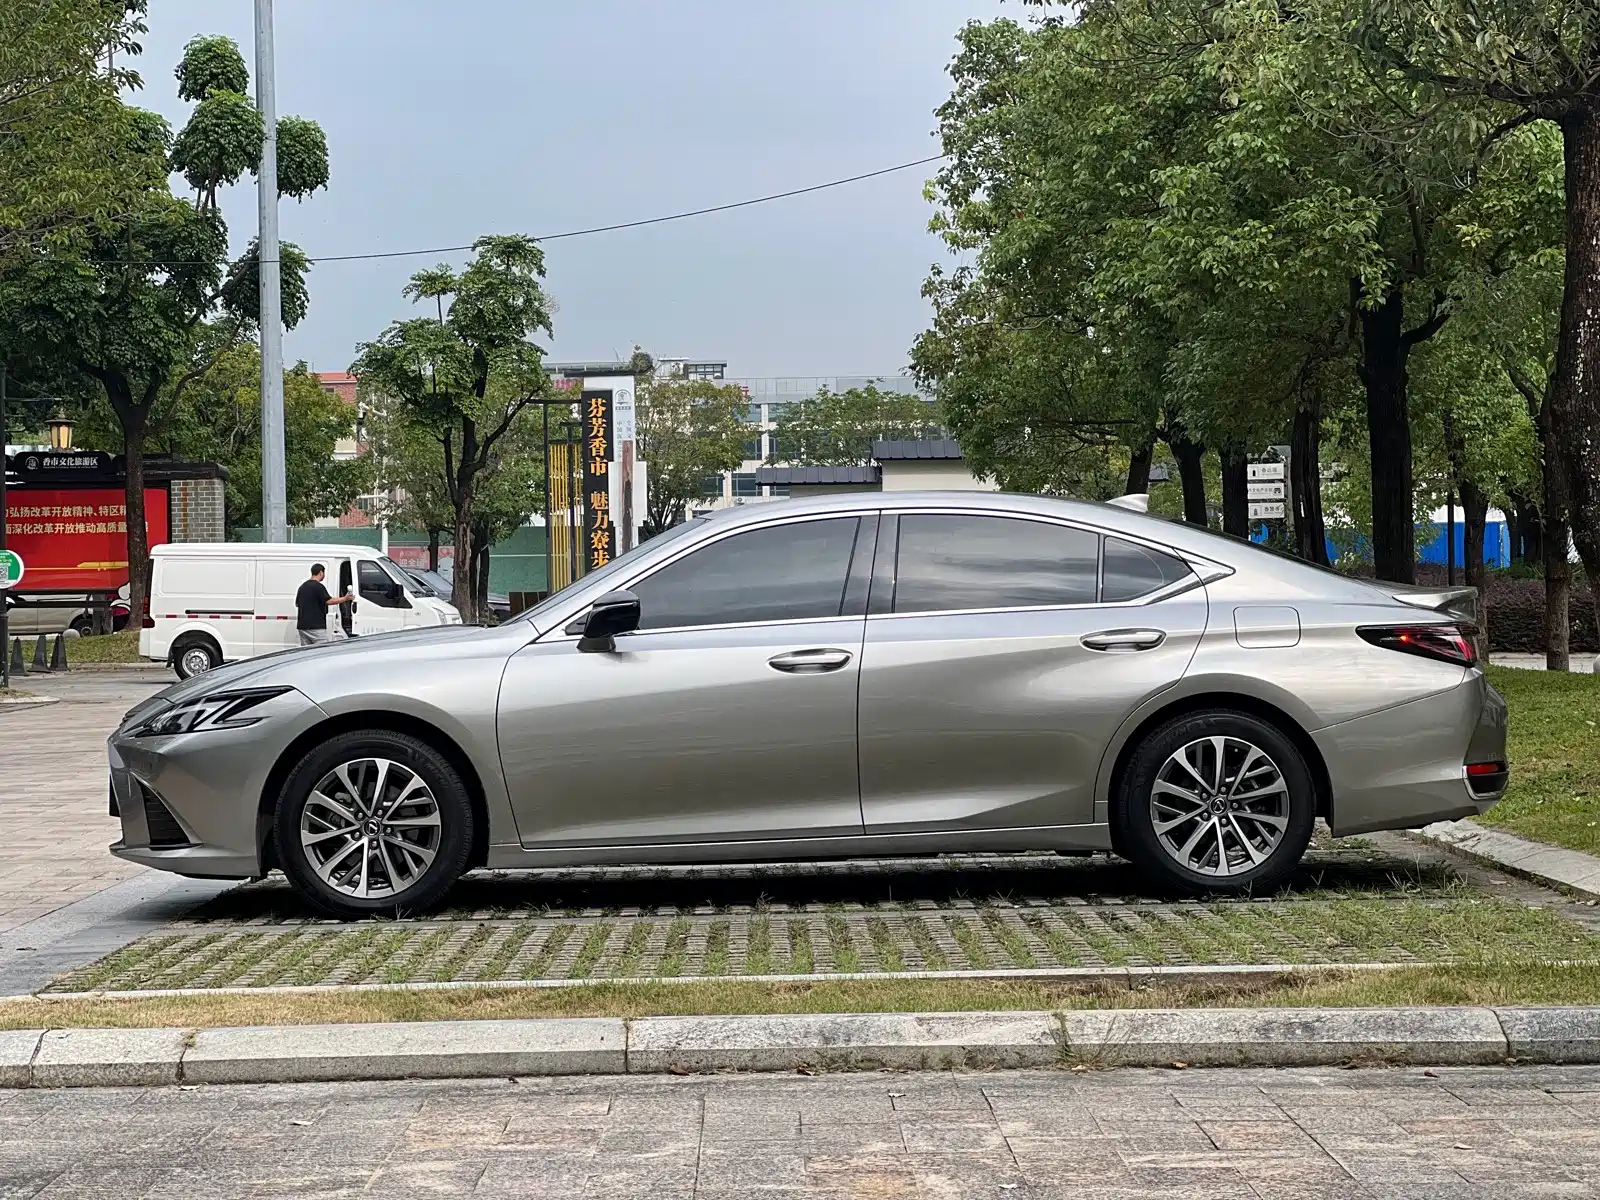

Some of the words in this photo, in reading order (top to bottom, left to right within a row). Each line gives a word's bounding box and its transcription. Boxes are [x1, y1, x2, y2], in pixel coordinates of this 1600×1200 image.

[588, 398, 607, 476] 芬芳香市
[43, 456, 98, 466] 香市文化旅游区
[5, 522, 148, 535] 面深化改革开放推动高质量
[590, 491, 610, 569] 魅力寮步
